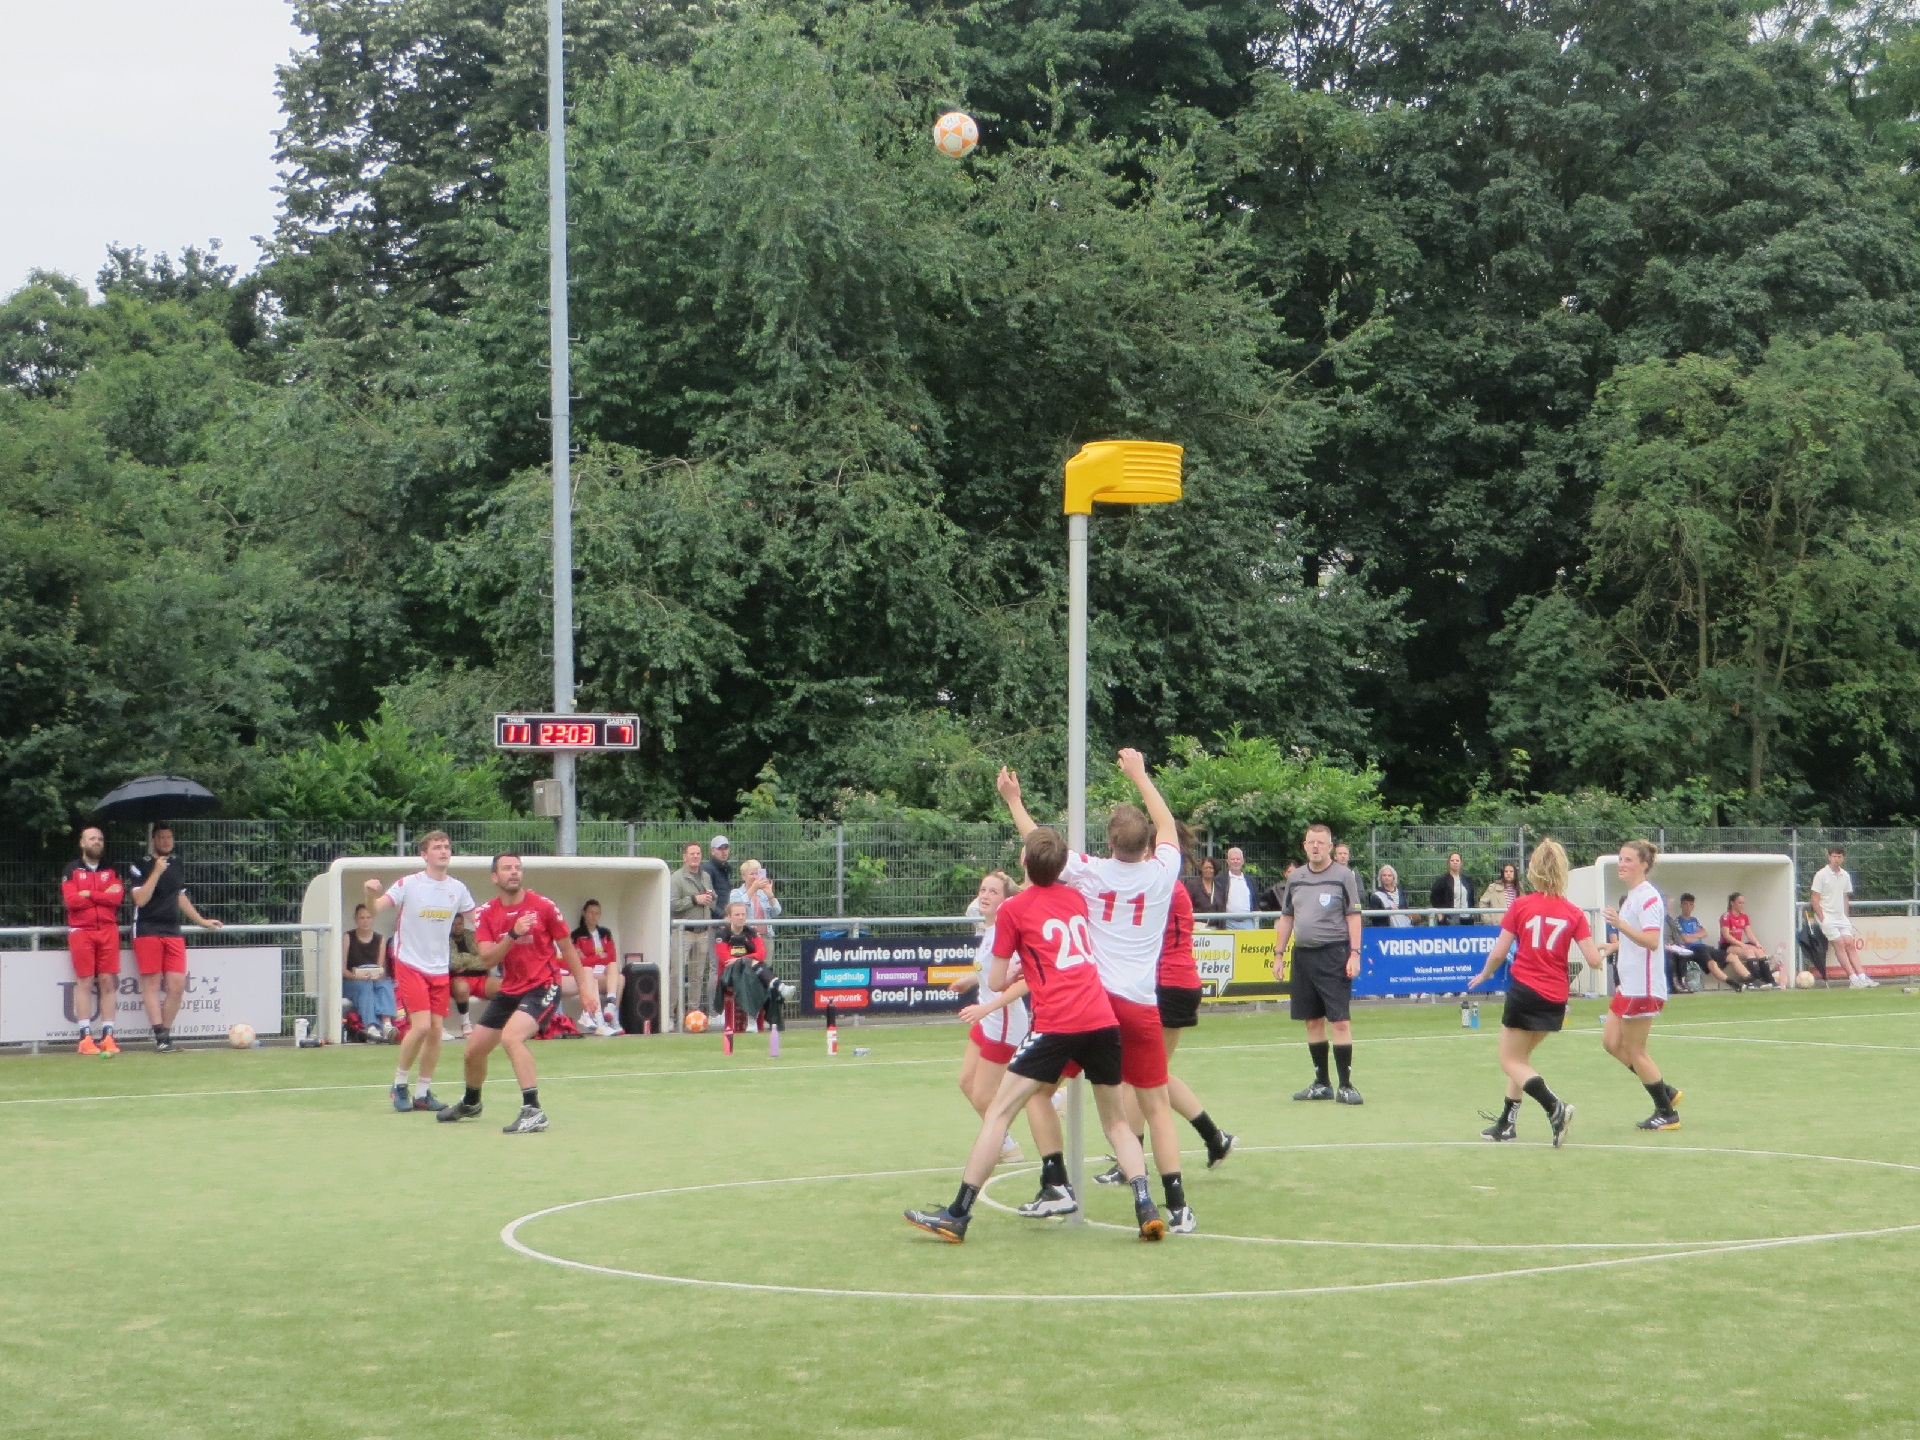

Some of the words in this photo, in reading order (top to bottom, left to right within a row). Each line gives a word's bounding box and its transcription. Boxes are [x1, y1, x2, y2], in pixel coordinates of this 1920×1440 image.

[507, 725, 528, 743] 11
[542, 726, 592, 743] 22:03
[621, 726, 631, 743] 7
[1097, 890, 1136, 927] 11
[1525, 914, 1568, 950] 17
[1042, 914, 1096, 970] 20
[1378, 937, 1499, 956] VRIENDENLOTER
[814, 947, 842, 962] Alle
[844, 946, 891, 961] ruimte
[892, 949, 916, 960] om
[918, 947, 932, 960] te
[1192, 948, 1232, 961] UMBO
[1201, 961, 1230, 973] Febre
[1414, 966, 1433, 974] Vriend
[823, 971, 865, 983] jeugdhulp
[876, 971, 918, 981] kraamzorg
[871, 987, 908, 1002] Groei
[909, 986, 923, 1006] je
[184, 1025, 198, 1033] 010
